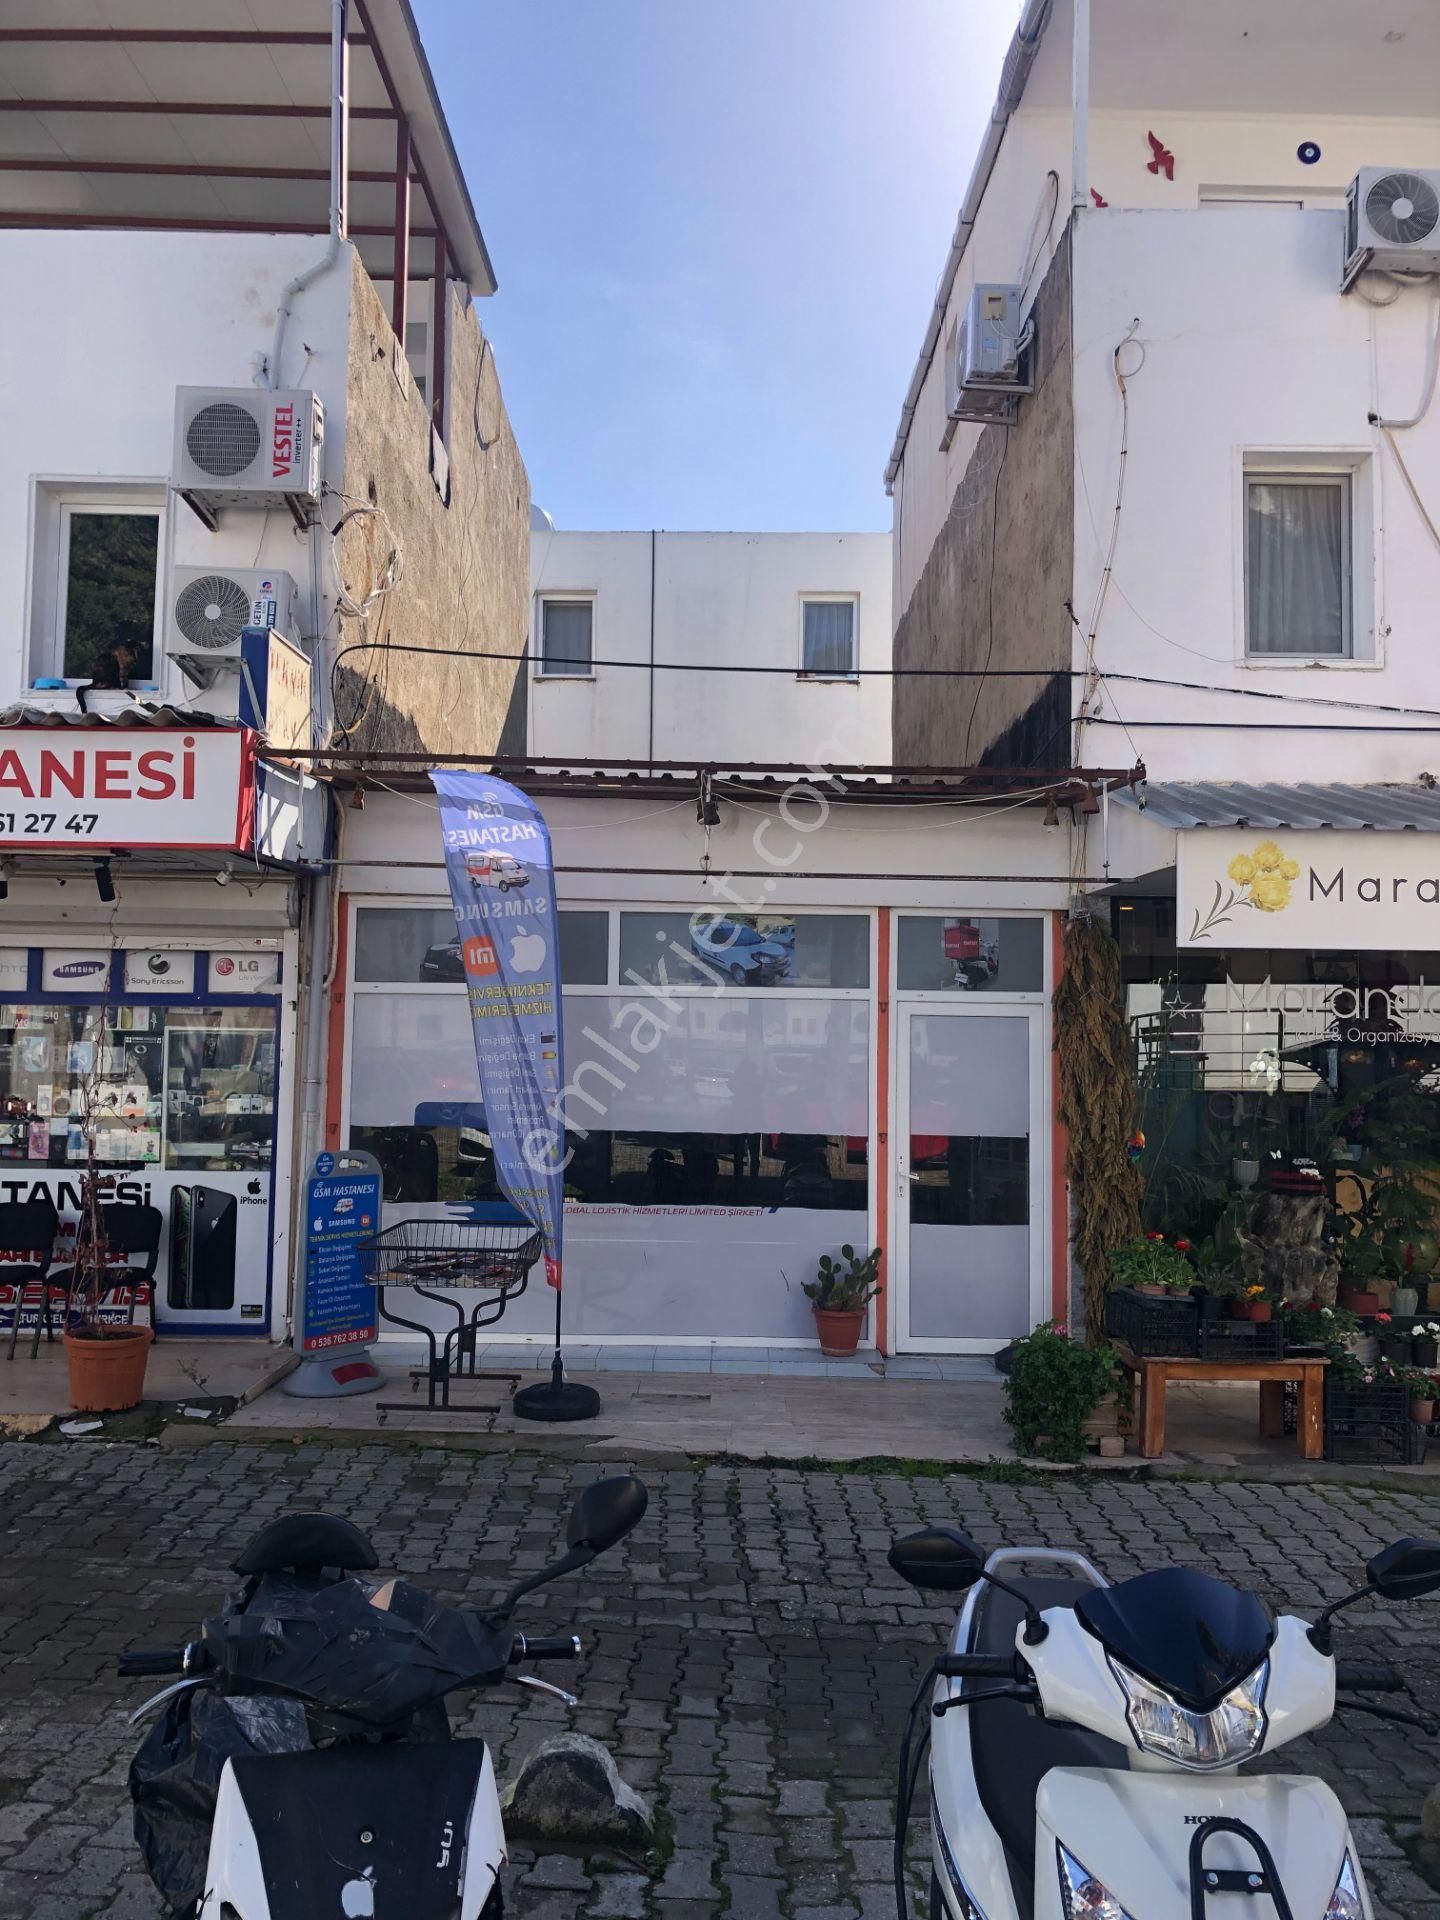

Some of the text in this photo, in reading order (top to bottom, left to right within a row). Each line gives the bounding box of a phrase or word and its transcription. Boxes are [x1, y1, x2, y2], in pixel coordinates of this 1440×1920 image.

[272, 402, 294, 478] VESTEL
[24, 813, 57, 833] 27
[65, 814, 99, 834] 47
[59, 966, 101, 974] SAMSUNG
[238, 960, 259, 973] LG
[131, 977, 184, 986] Sony Ericsson
[313, 1187, 331, 1198] GSM
[240, 1196, 267, 1205] iPhone
[633, 1206, 689, 1216] HİZMETLERİ
[311, 1339, 317, 1348] 0
